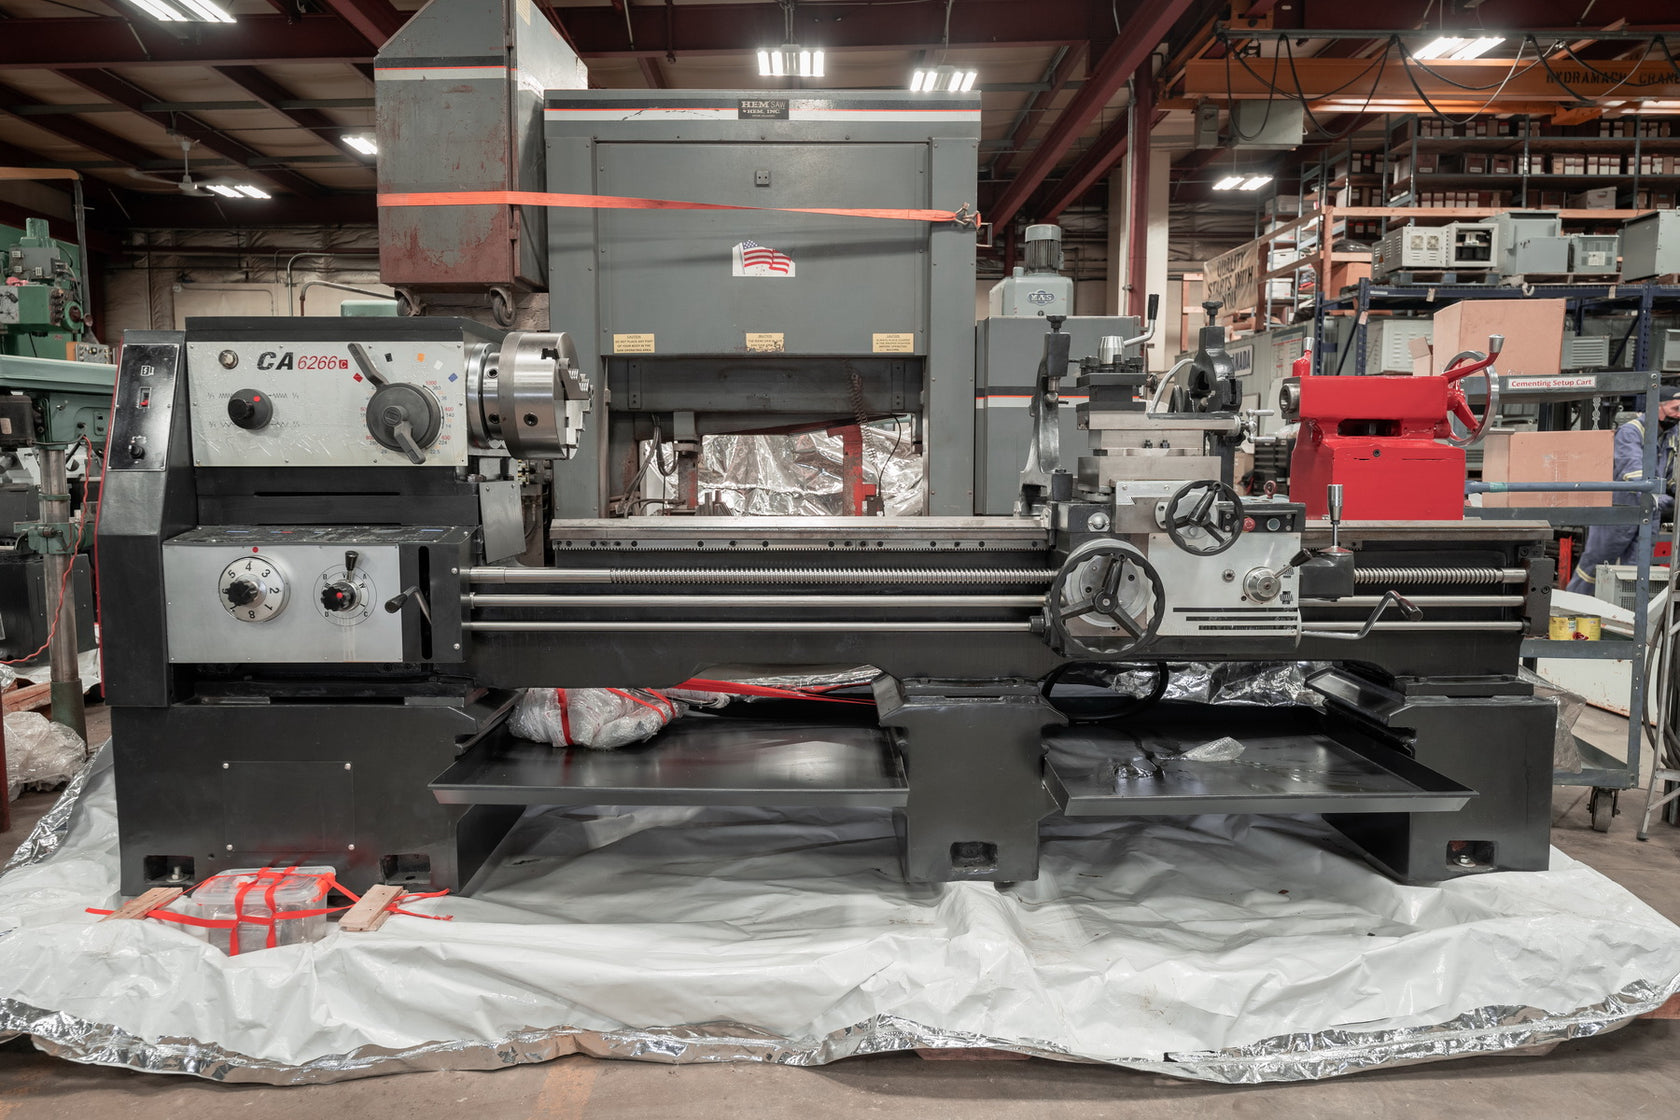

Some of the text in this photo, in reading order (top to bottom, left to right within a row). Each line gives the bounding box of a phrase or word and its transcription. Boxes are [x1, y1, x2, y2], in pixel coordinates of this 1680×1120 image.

[1217, 251, 1246, 278] QUALITY
[1208, 265, 1254, 298] STARTS WITH
[1222, 290, 1237, 310] YOU
[257, 352, 293, 370] CA
[297, 356, 338, 370] 6266
[245, 561, 252, 571] 4
[228, 570, 236, 578] 5
[262, 569, 270, 578] 3
[248, 610, 255, 618] 8
